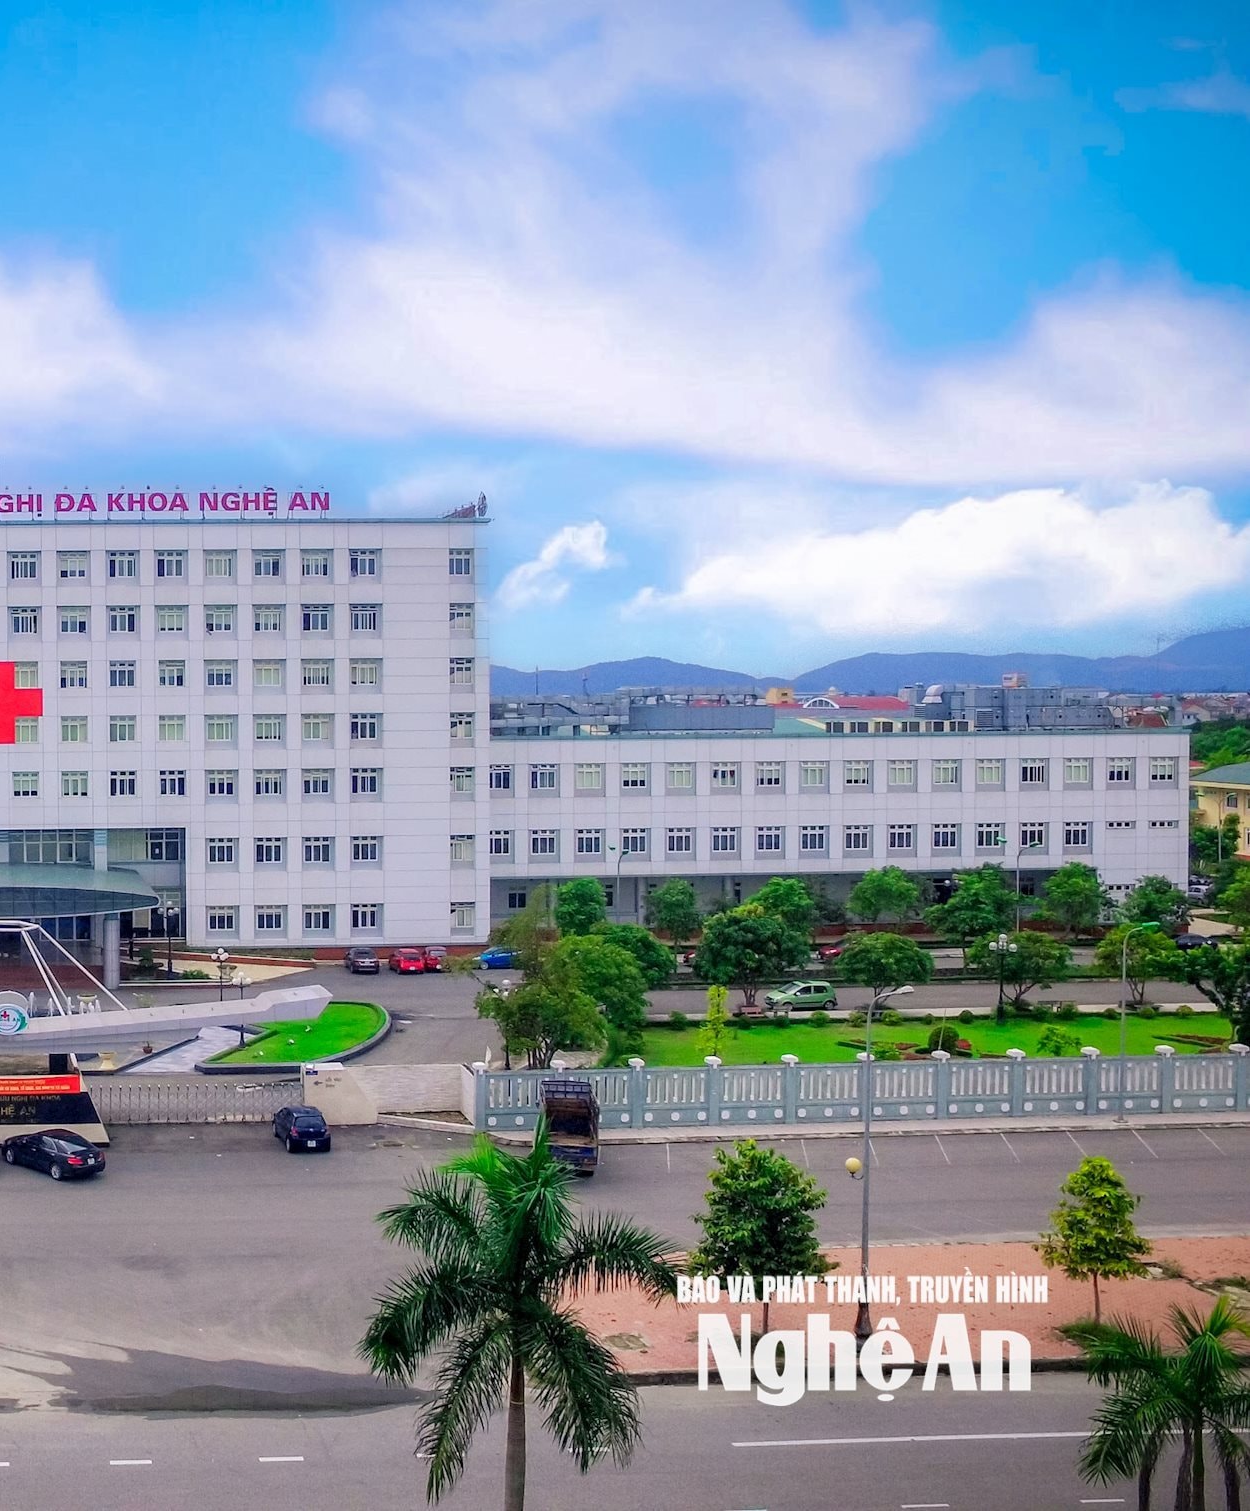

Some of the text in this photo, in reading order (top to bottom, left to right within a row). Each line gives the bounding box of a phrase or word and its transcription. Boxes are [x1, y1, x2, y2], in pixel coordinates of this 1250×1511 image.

[54, 492, 97, 512] ĐA
[107, 492, 189, 512] KHOA
[200, 487, 278, 515] NGHỆ
[289, 492, 330, 511] AN
